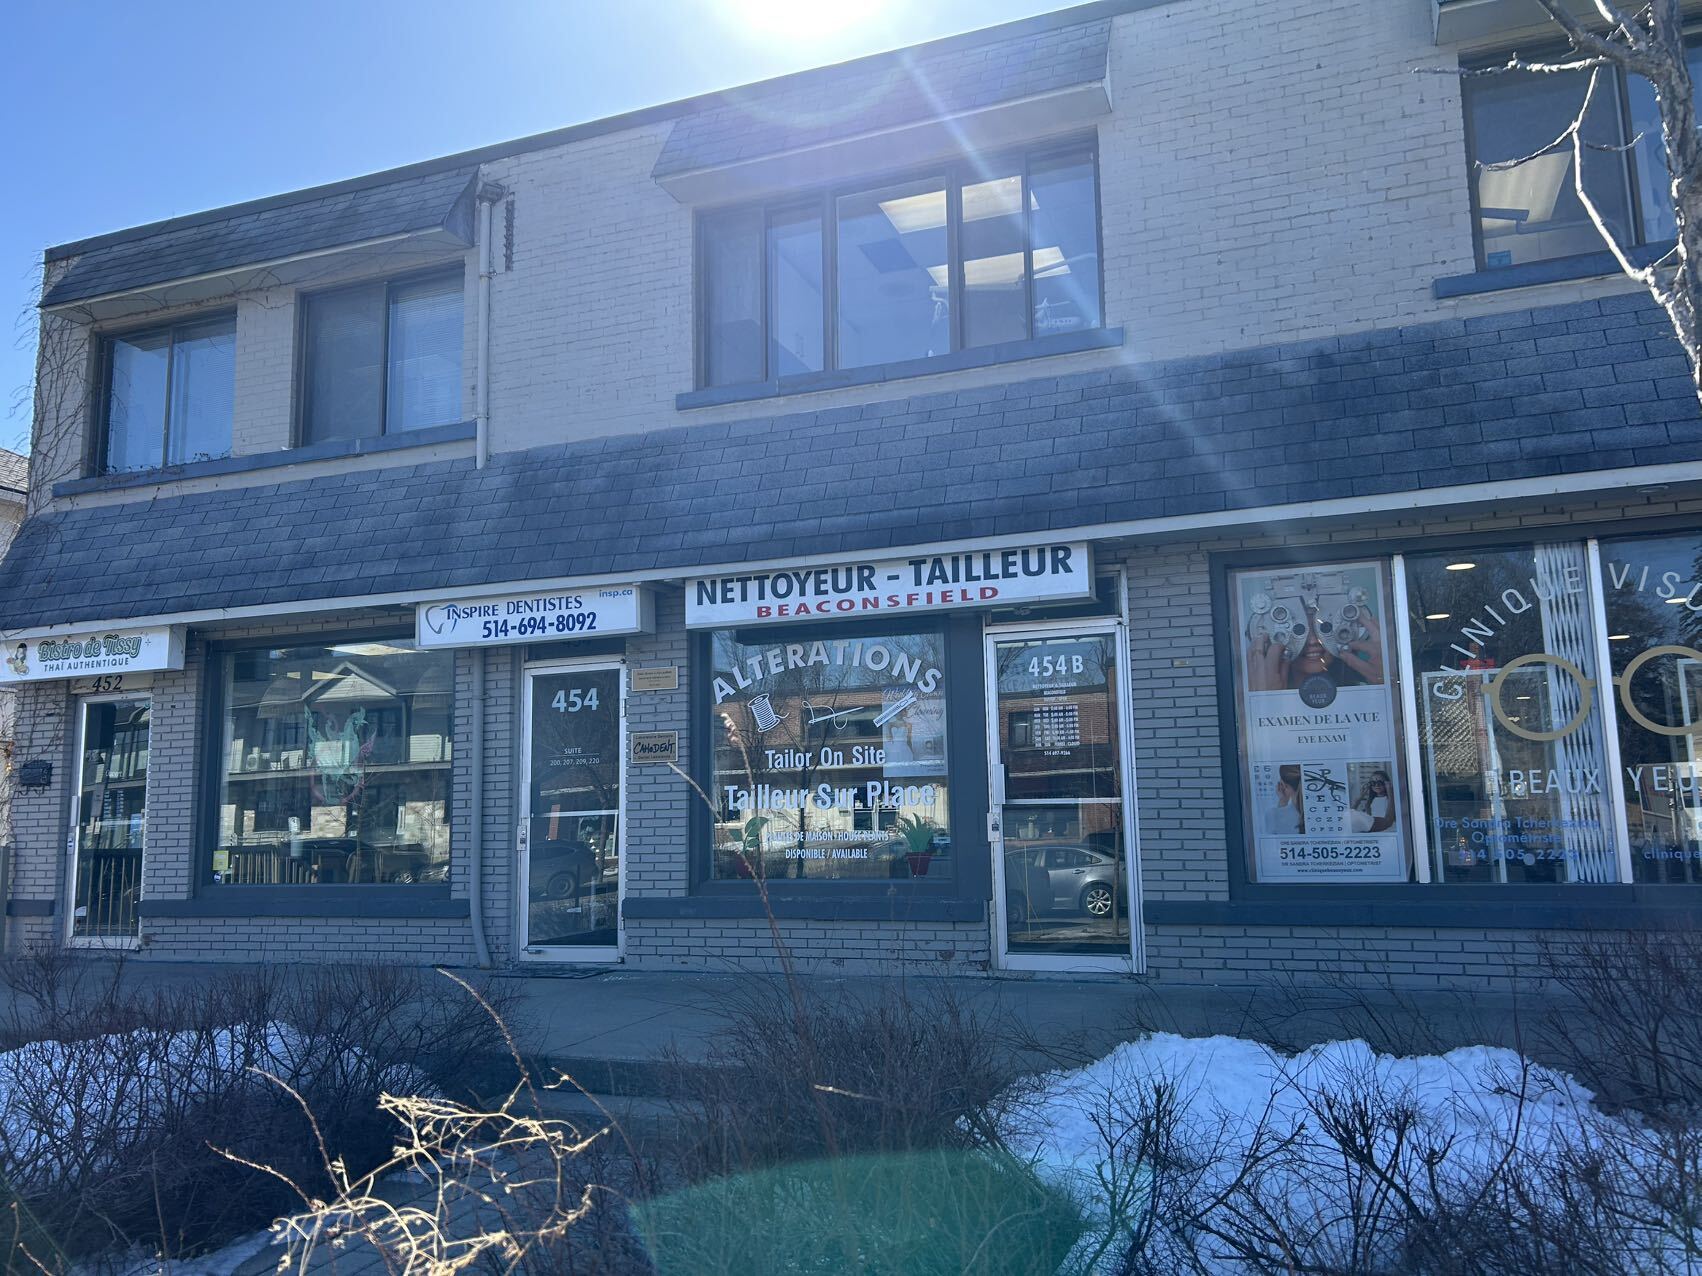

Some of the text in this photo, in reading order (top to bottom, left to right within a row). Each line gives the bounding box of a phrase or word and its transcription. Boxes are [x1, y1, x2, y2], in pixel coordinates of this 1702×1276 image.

[697, 565, 877, 605] NETTOYEUR
[908, 545, 1073, 587] TAILLEUR
[599, 589, 633, 599] insp.ca
[757, 586, 999, 618] BEACONSFIELD
[447, 596, 582, 620] INSPIRE DENTISTES
[482, 611, 597, 639] 514-694-8092
[1433, 566, 1583, 700] CLINIQUE
[38, 634, 142, 662] Bistro de Tissy
[67, 658, 129, 669] AUTHENTIQUE
[712, 639, 943, 704] ALTERATIONS
[92, 675, 123, 691] 452
[551, 687, 600, 713] 454
[1258, 711, 1380, 728] EXAMEN DE LA VUE
[563, 747, 582, 755] SUITE
[1298, 734, 1346, 744] EYE EXAM
[765, 745, 887, 769] Tailor On Site
[1509, 765, 1702, 795] BEAUX YEU
[724, 780, 936, 811] Tailleur Sur Place
[806, 831, 833, 841] MAISON
[785, 848, 825, 859] DISPONIBLE
[832, 848, 868, 859] AVAILABLE
[1280, 846, 1381, 860] 514-505-2223
